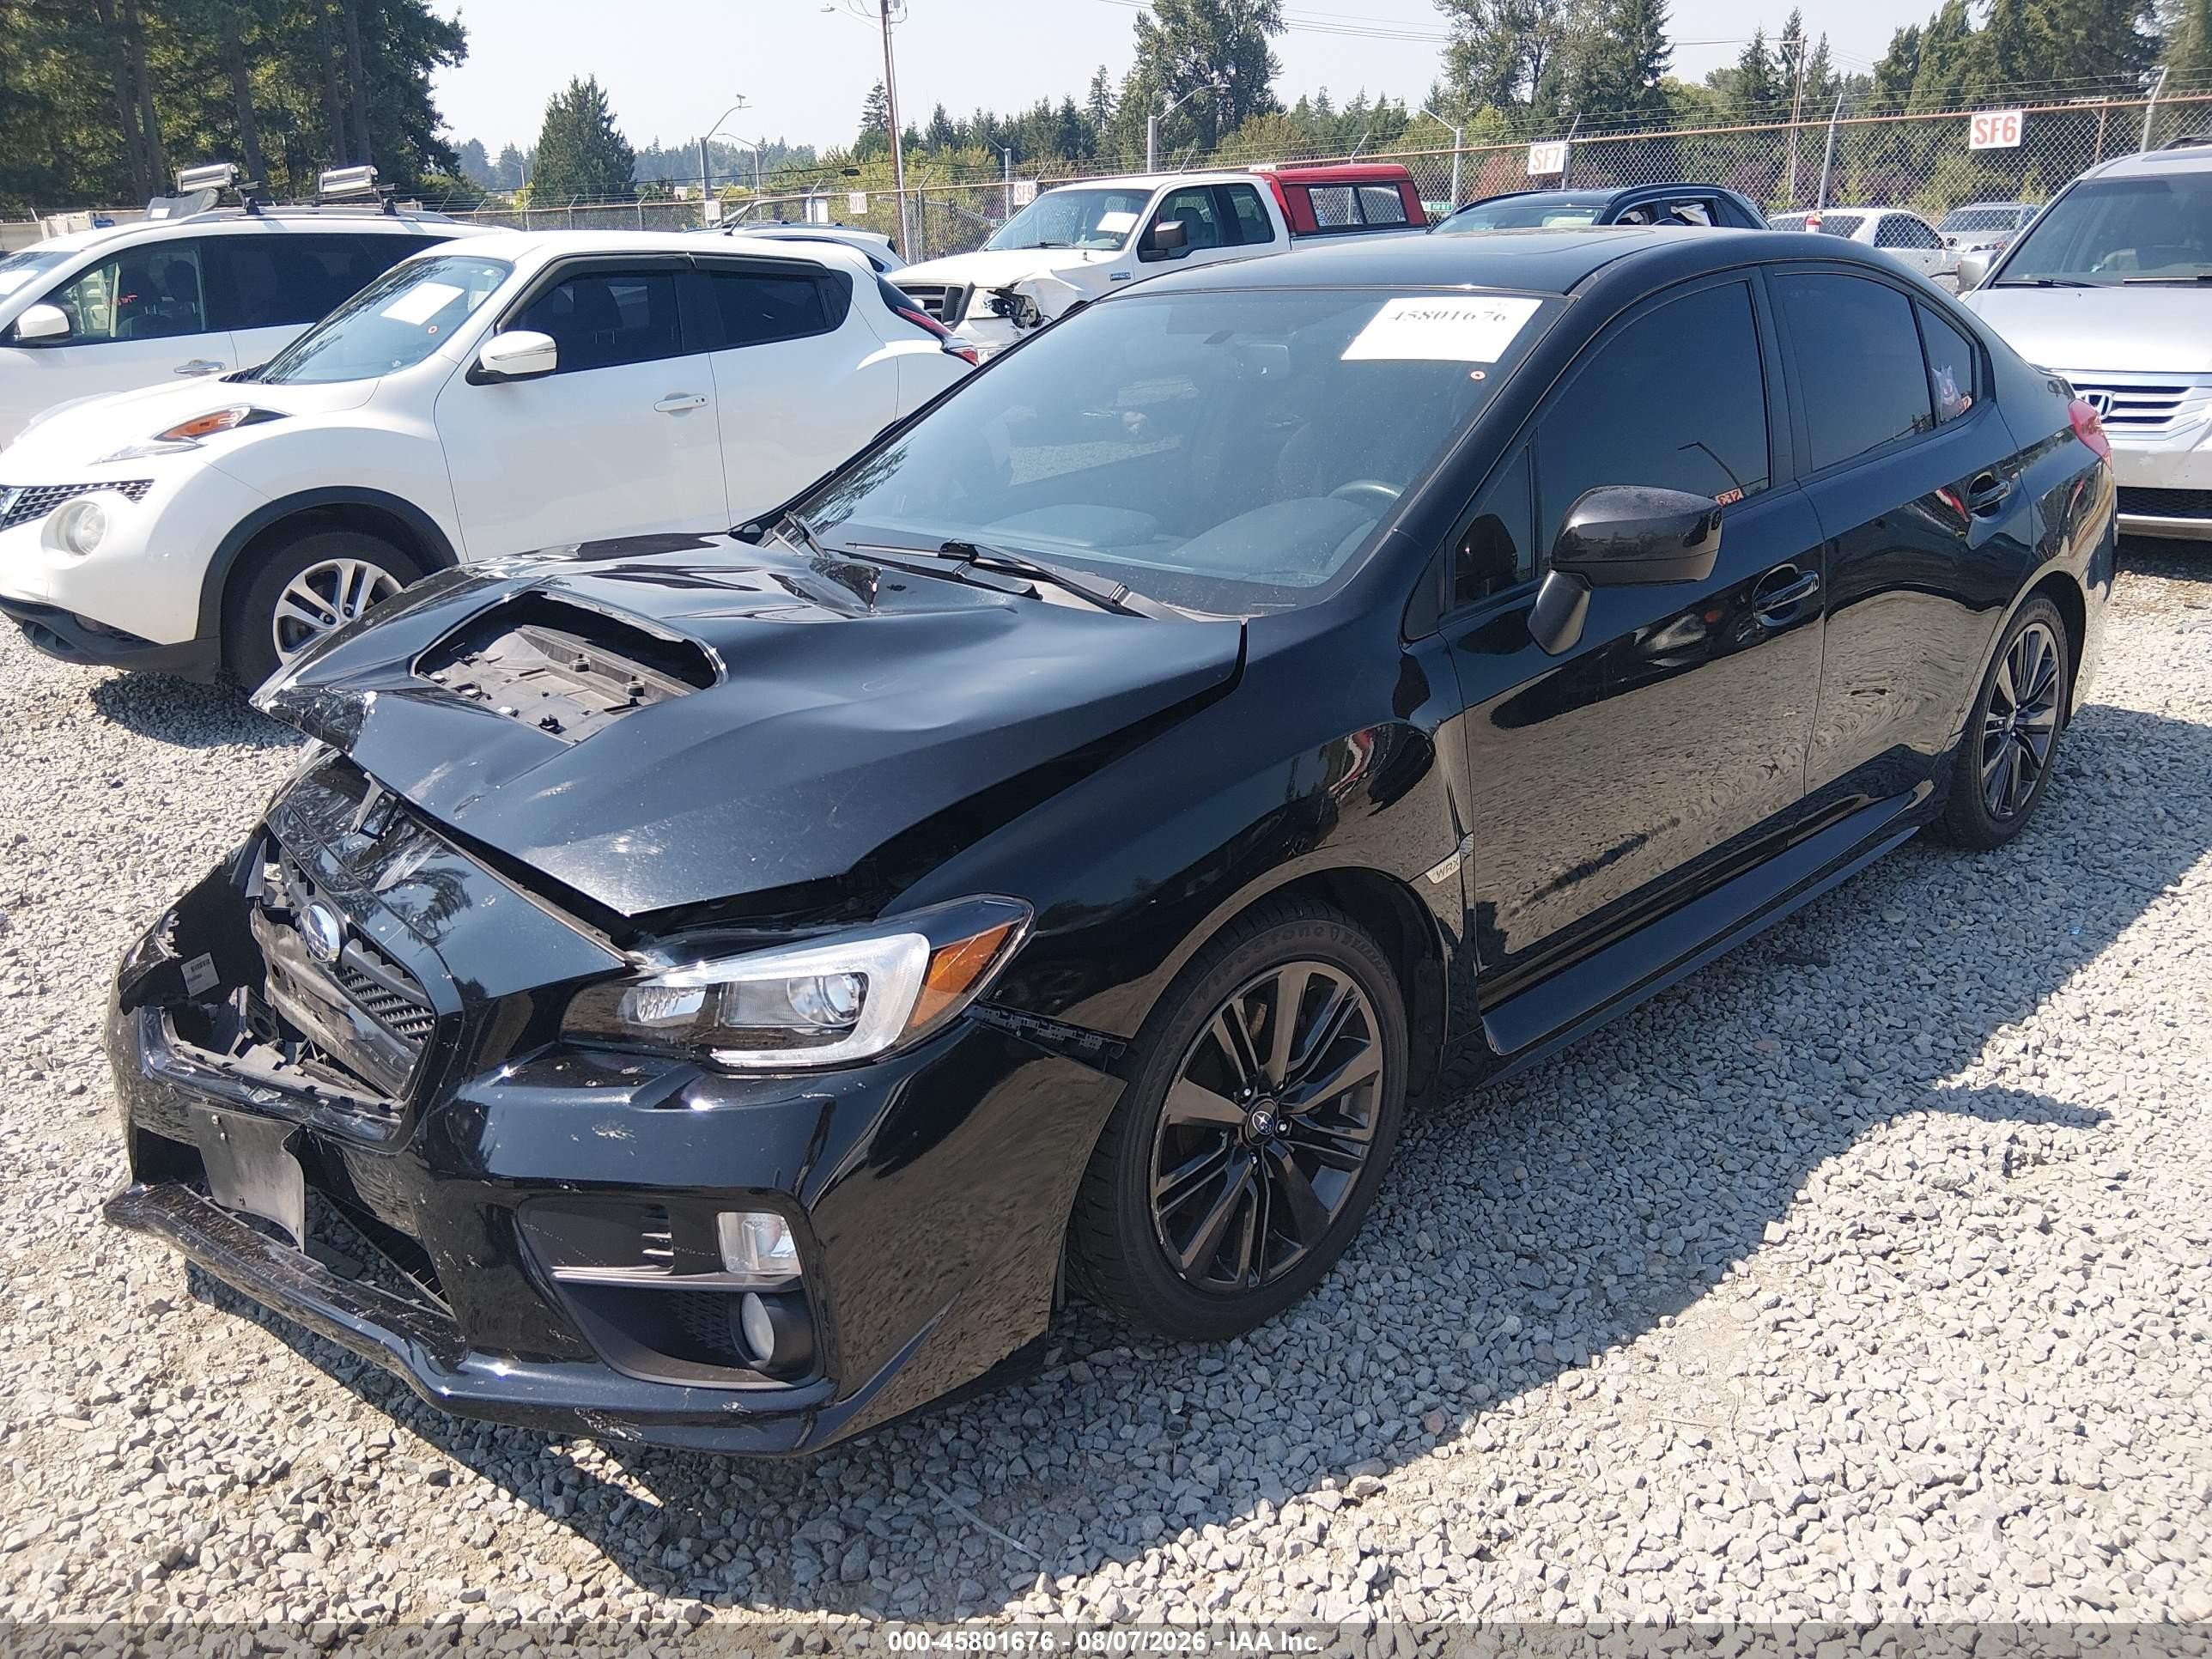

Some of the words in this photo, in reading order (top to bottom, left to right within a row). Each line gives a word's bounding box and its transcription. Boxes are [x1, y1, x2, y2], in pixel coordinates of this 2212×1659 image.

[1974, 115, 2017, 145] SF6
[1533, 146, 1561, 171] SF7
[850, 196, 866, 211] SF10
[1016, 185, 1033, 203] SF9
[1387, 309, 1508, 322] 45801676
[1435, 857, 1459, 880] WRX
